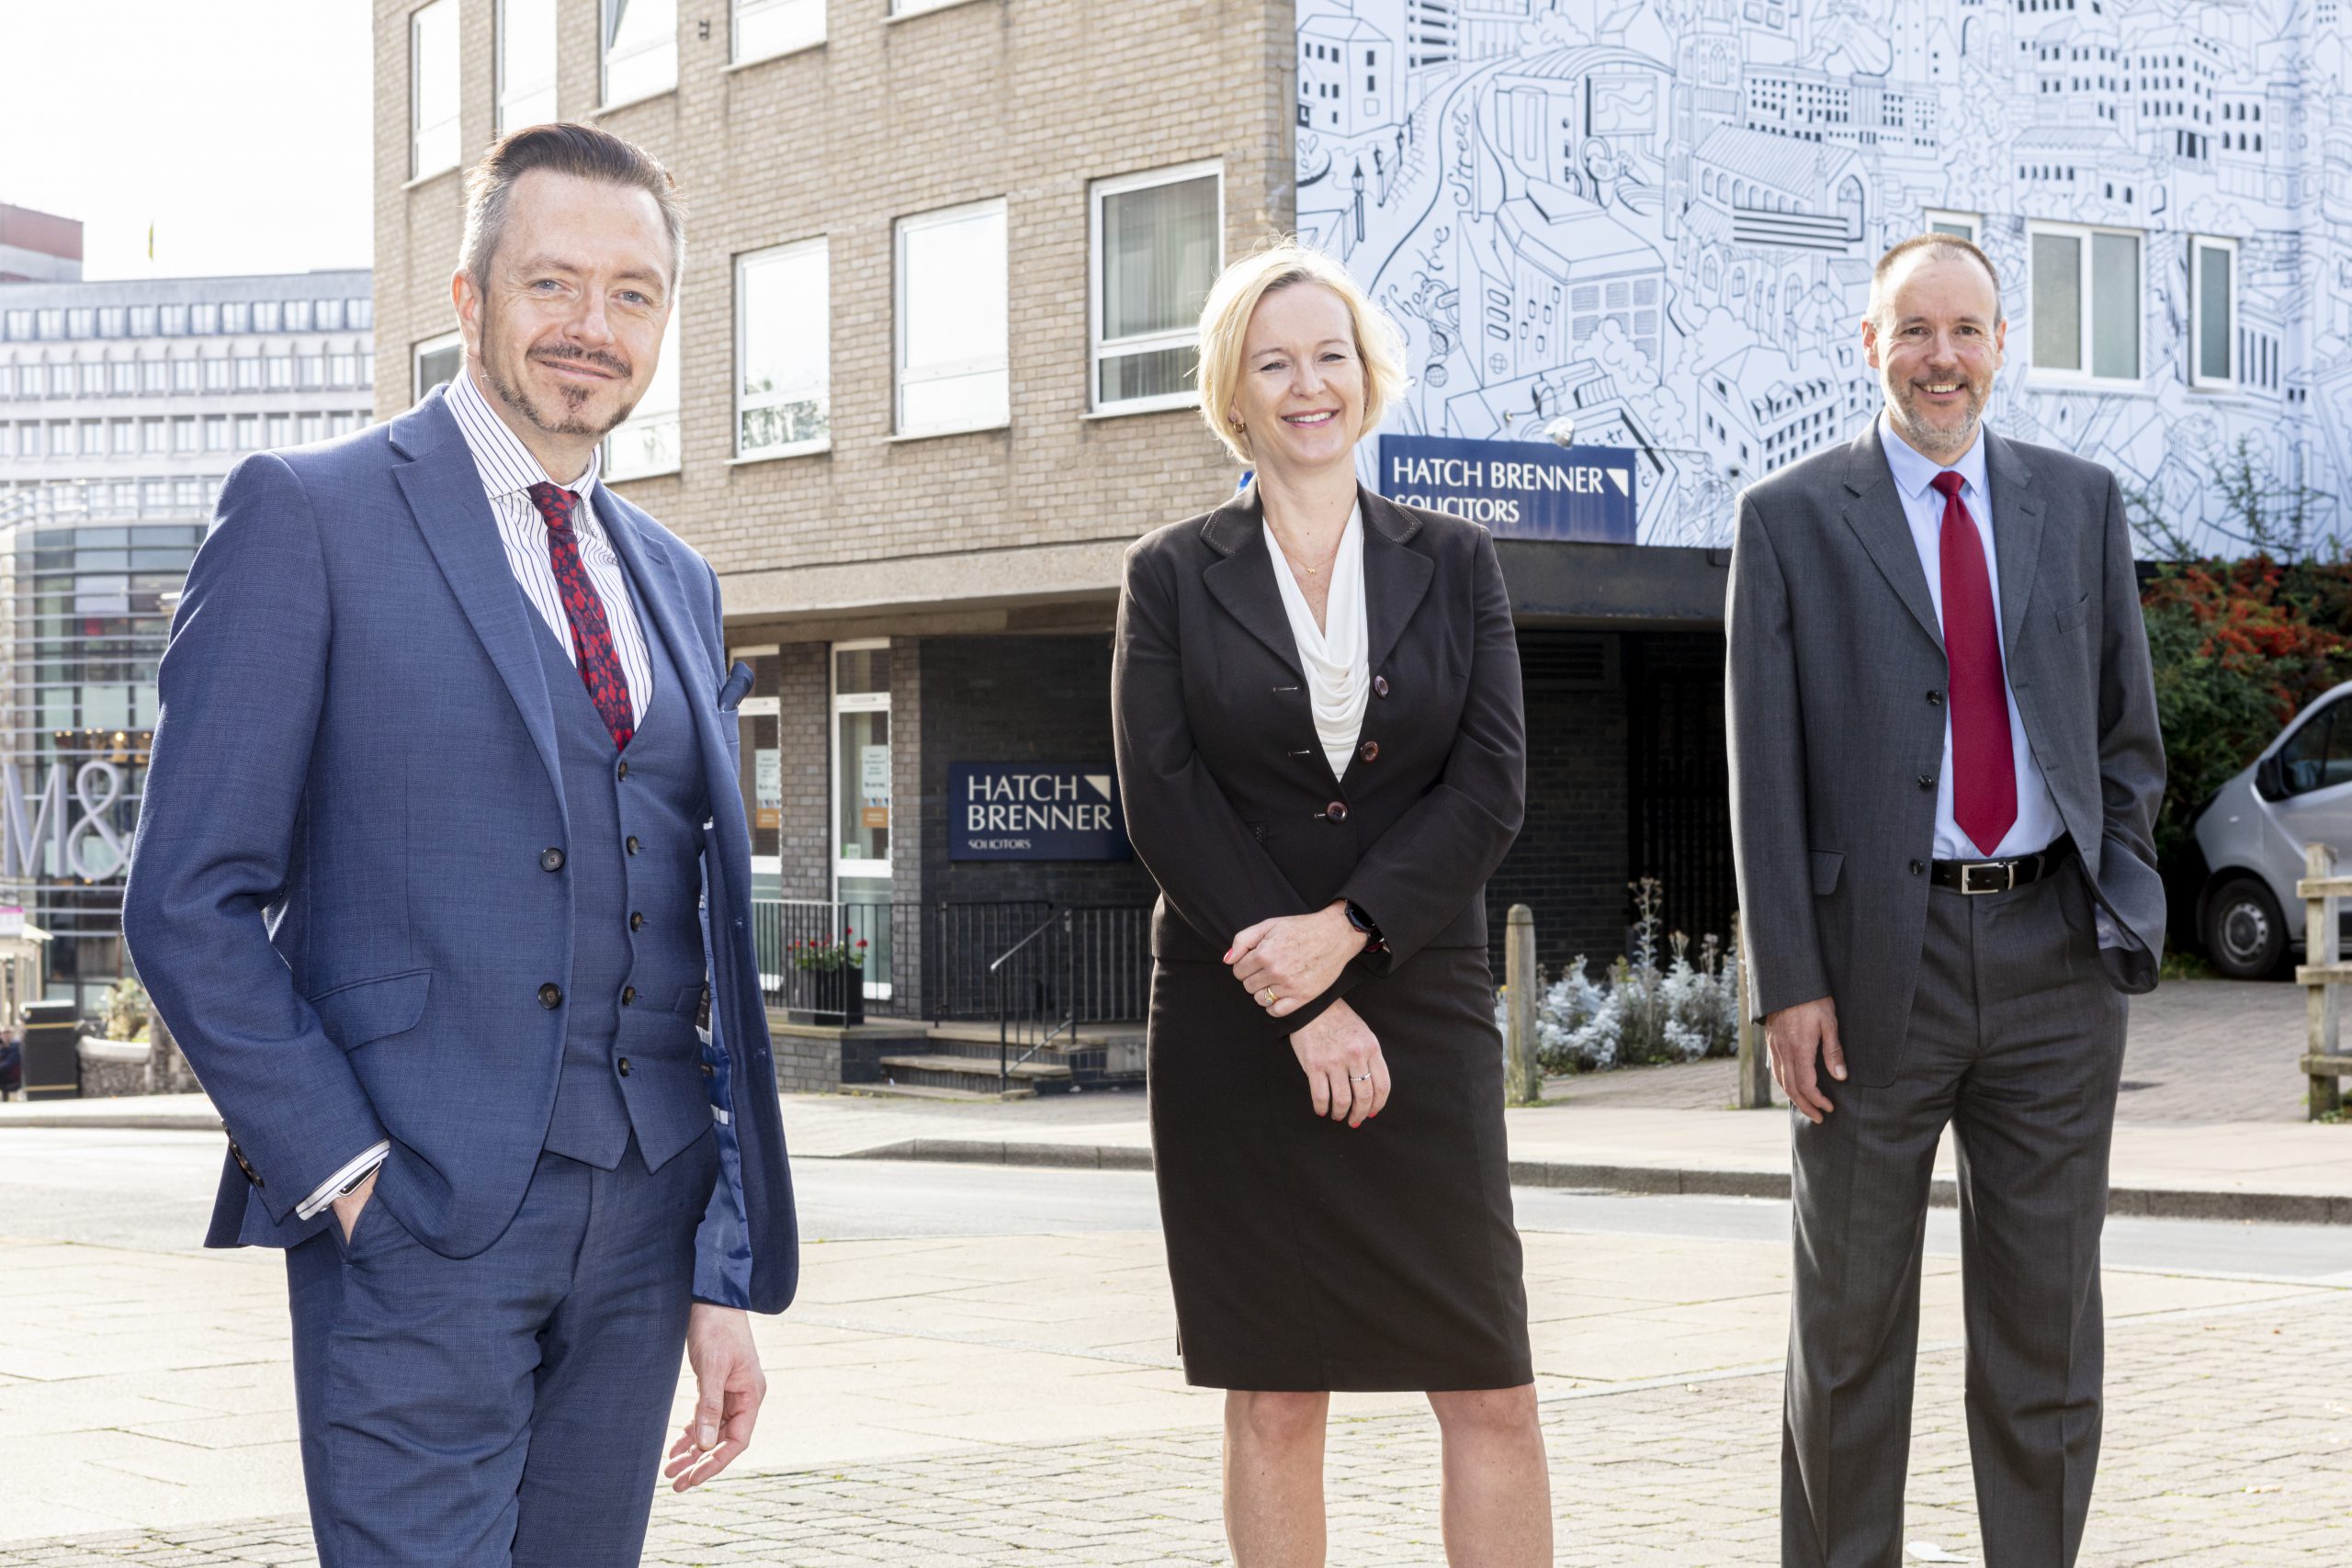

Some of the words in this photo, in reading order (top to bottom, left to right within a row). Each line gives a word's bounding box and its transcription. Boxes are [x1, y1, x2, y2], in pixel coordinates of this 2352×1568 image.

[1393, 457, 1482, 488] HATCH
[1490, 461, 1604, 494] BRENNER
[968, 774, 1078, 802] HATCH
[967, 805, 1113, 831] BRENNER
[968, 839, 1031, 850] SOLICITORS
